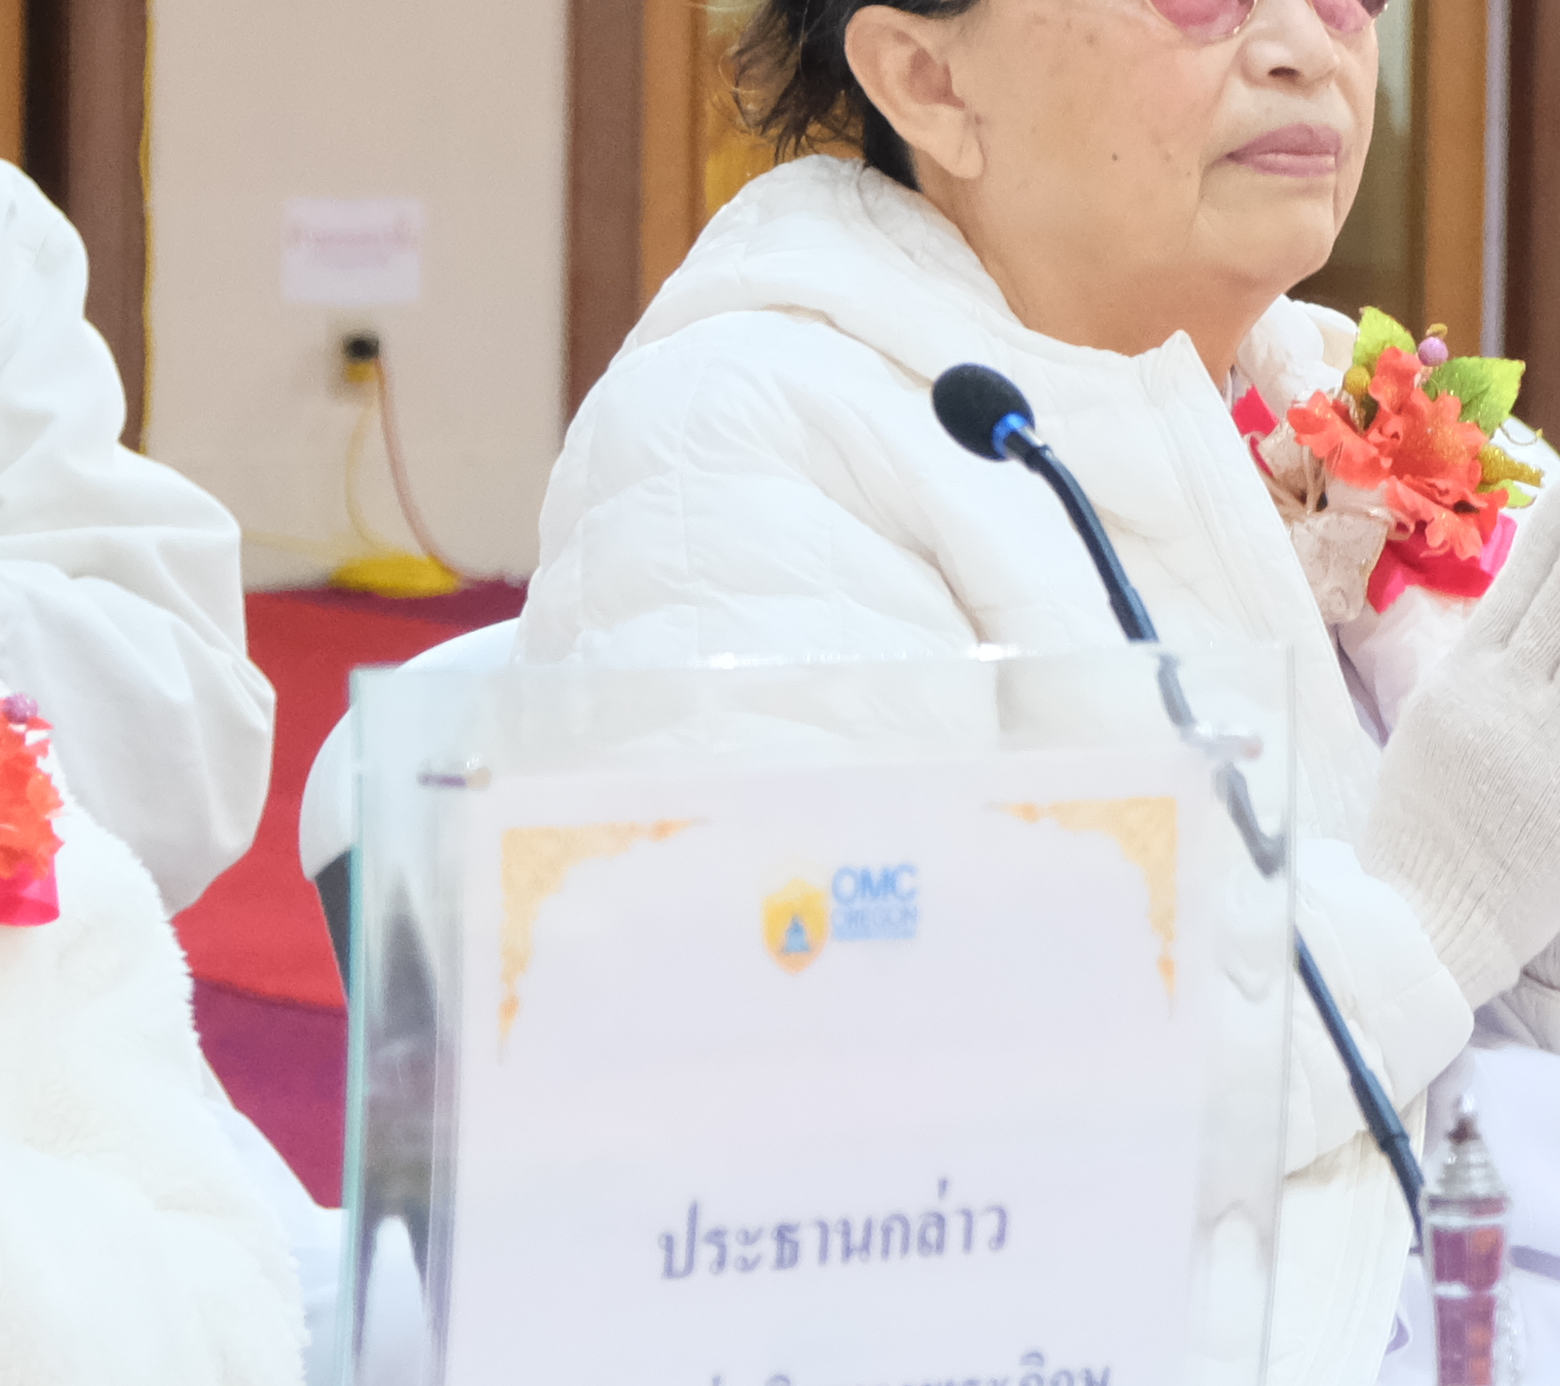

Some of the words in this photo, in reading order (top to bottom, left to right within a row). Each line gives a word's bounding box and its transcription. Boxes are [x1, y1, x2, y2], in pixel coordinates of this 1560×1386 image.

[831, 861, 919, 905] OMC
[657, 1175, 1011, 1282] ประธานกล่าว
